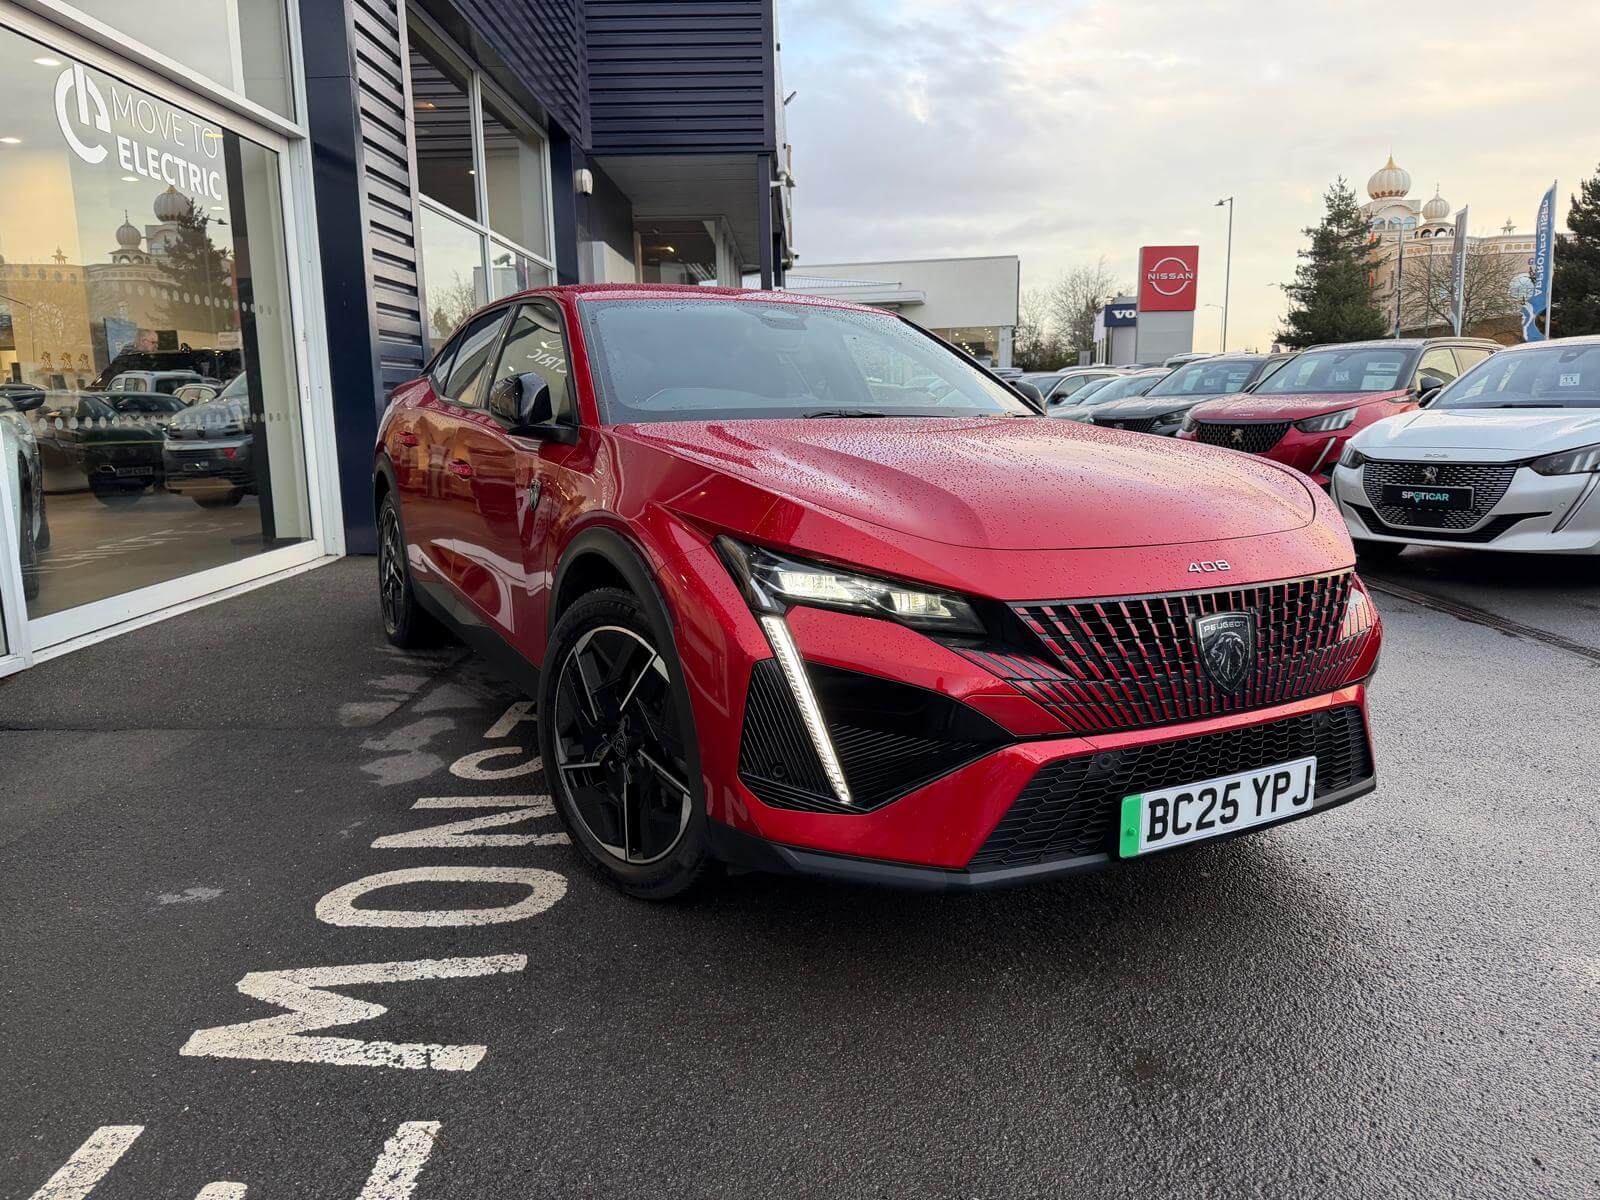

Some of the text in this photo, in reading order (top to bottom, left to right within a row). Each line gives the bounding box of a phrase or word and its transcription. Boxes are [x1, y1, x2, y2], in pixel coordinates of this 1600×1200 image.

[111, 86, 218, 159] MOVE TO
[117, 135, 222, 200] ELECTRIC
[1147, 272, 1193, 280] NISSAN
[1112, 309, 1137, 319] VO
[1188, 559, 1231, 573] 408
[1203, 620, 1246, 633] PEUGEOT
[1146, 765, 1313, 843] BC25 YPJ
